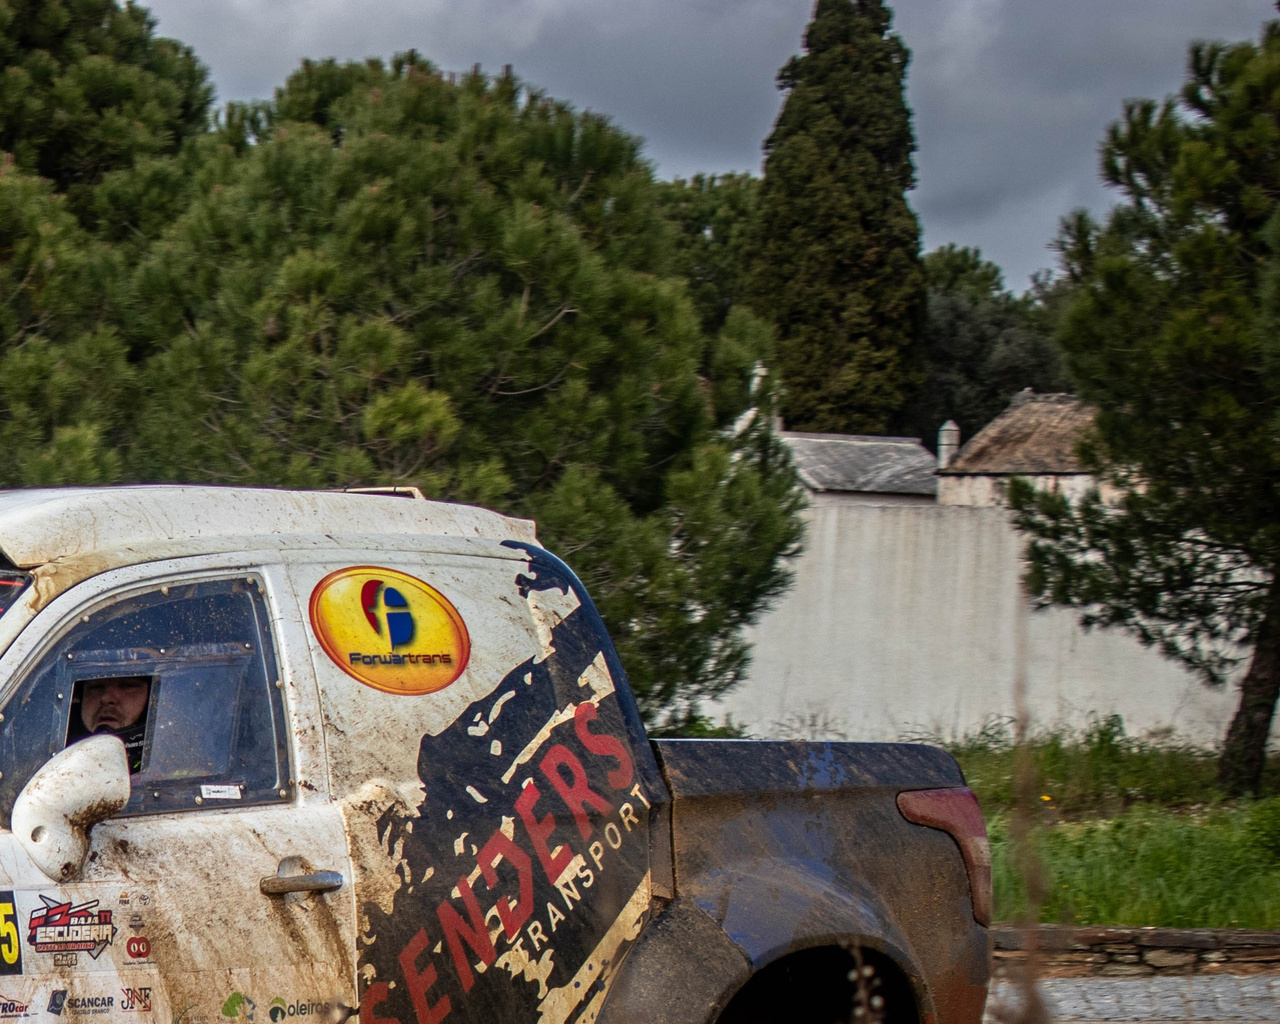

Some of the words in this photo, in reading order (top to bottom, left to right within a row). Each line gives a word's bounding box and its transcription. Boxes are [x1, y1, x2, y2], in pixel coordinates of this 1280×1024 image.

[349, 652, 452, 665] Forwartrans
[512, 783, 651, 958] TRANSPORT
[70, 916, 99, 925] BAJA
[36, 924, 113, 945] ESCUDERIA
[67, 996, 114, 1009] SCANCAR
[287, 999, 330, 1017] oleiros
